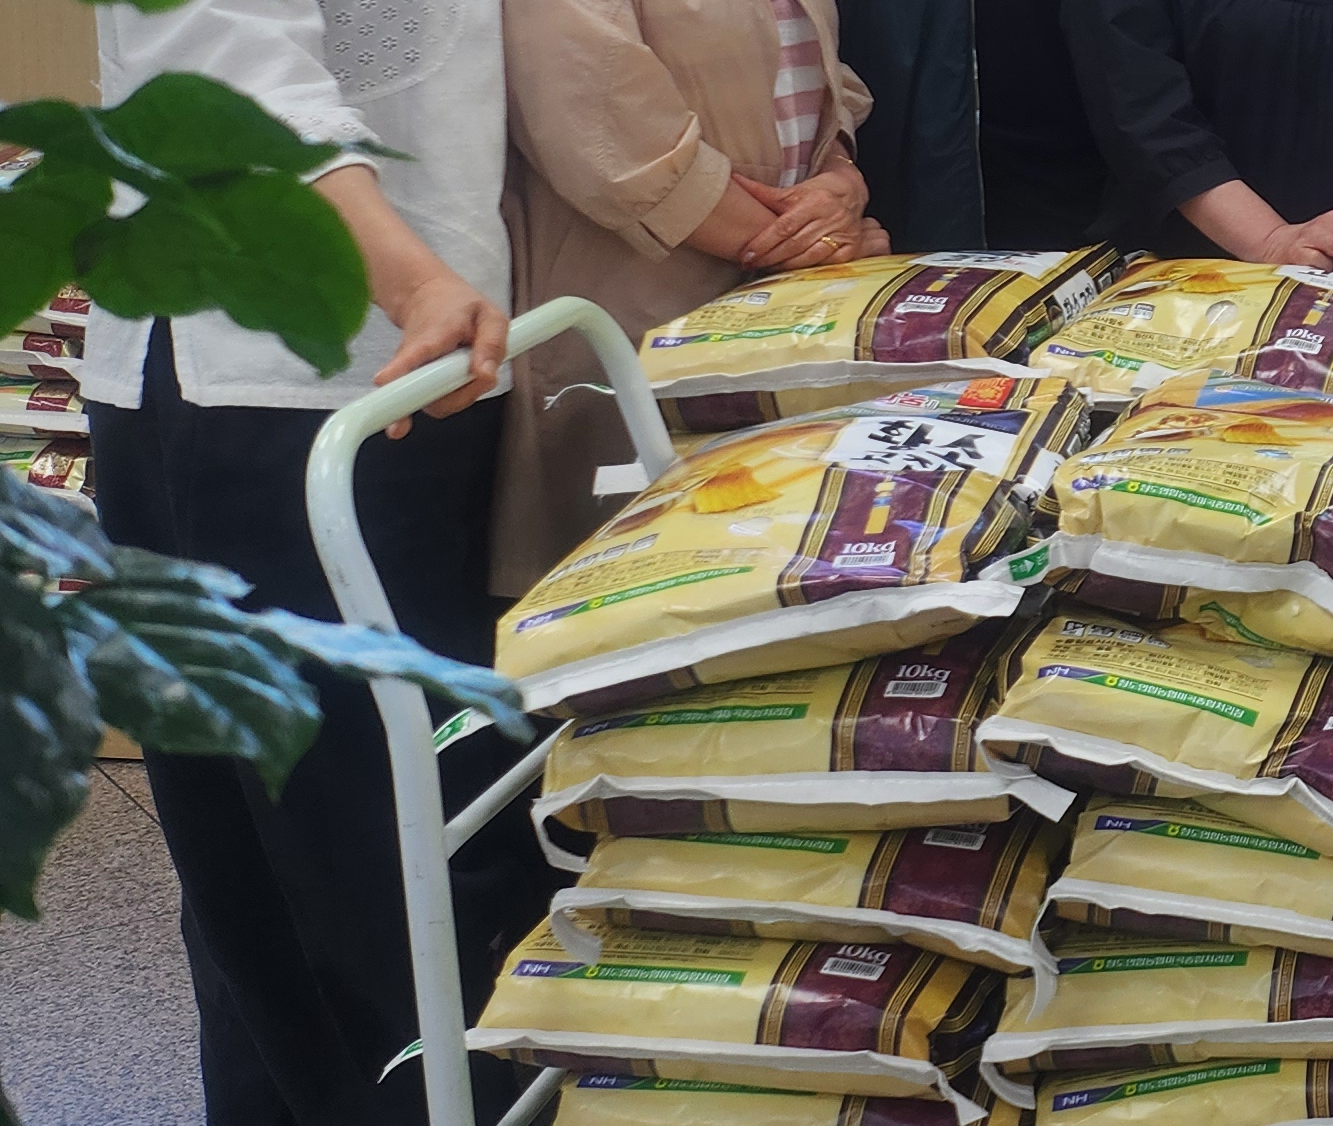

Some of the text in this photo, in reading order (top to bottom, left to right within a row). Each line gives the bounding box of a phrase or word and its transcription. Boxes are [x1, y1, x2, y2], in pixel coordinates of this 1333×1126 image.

[906, 294, 948, 305] 10kg
[1287, 328, 1325, 344] 10kg
[842, 540, 897, 554] 10kg
[896, 664, 951, 682] 10kg
[1105, 818, 1132, 830] NH
[837, 944, 892, 965] 10kg
[1062, 1092, 1090, 1106] NH
